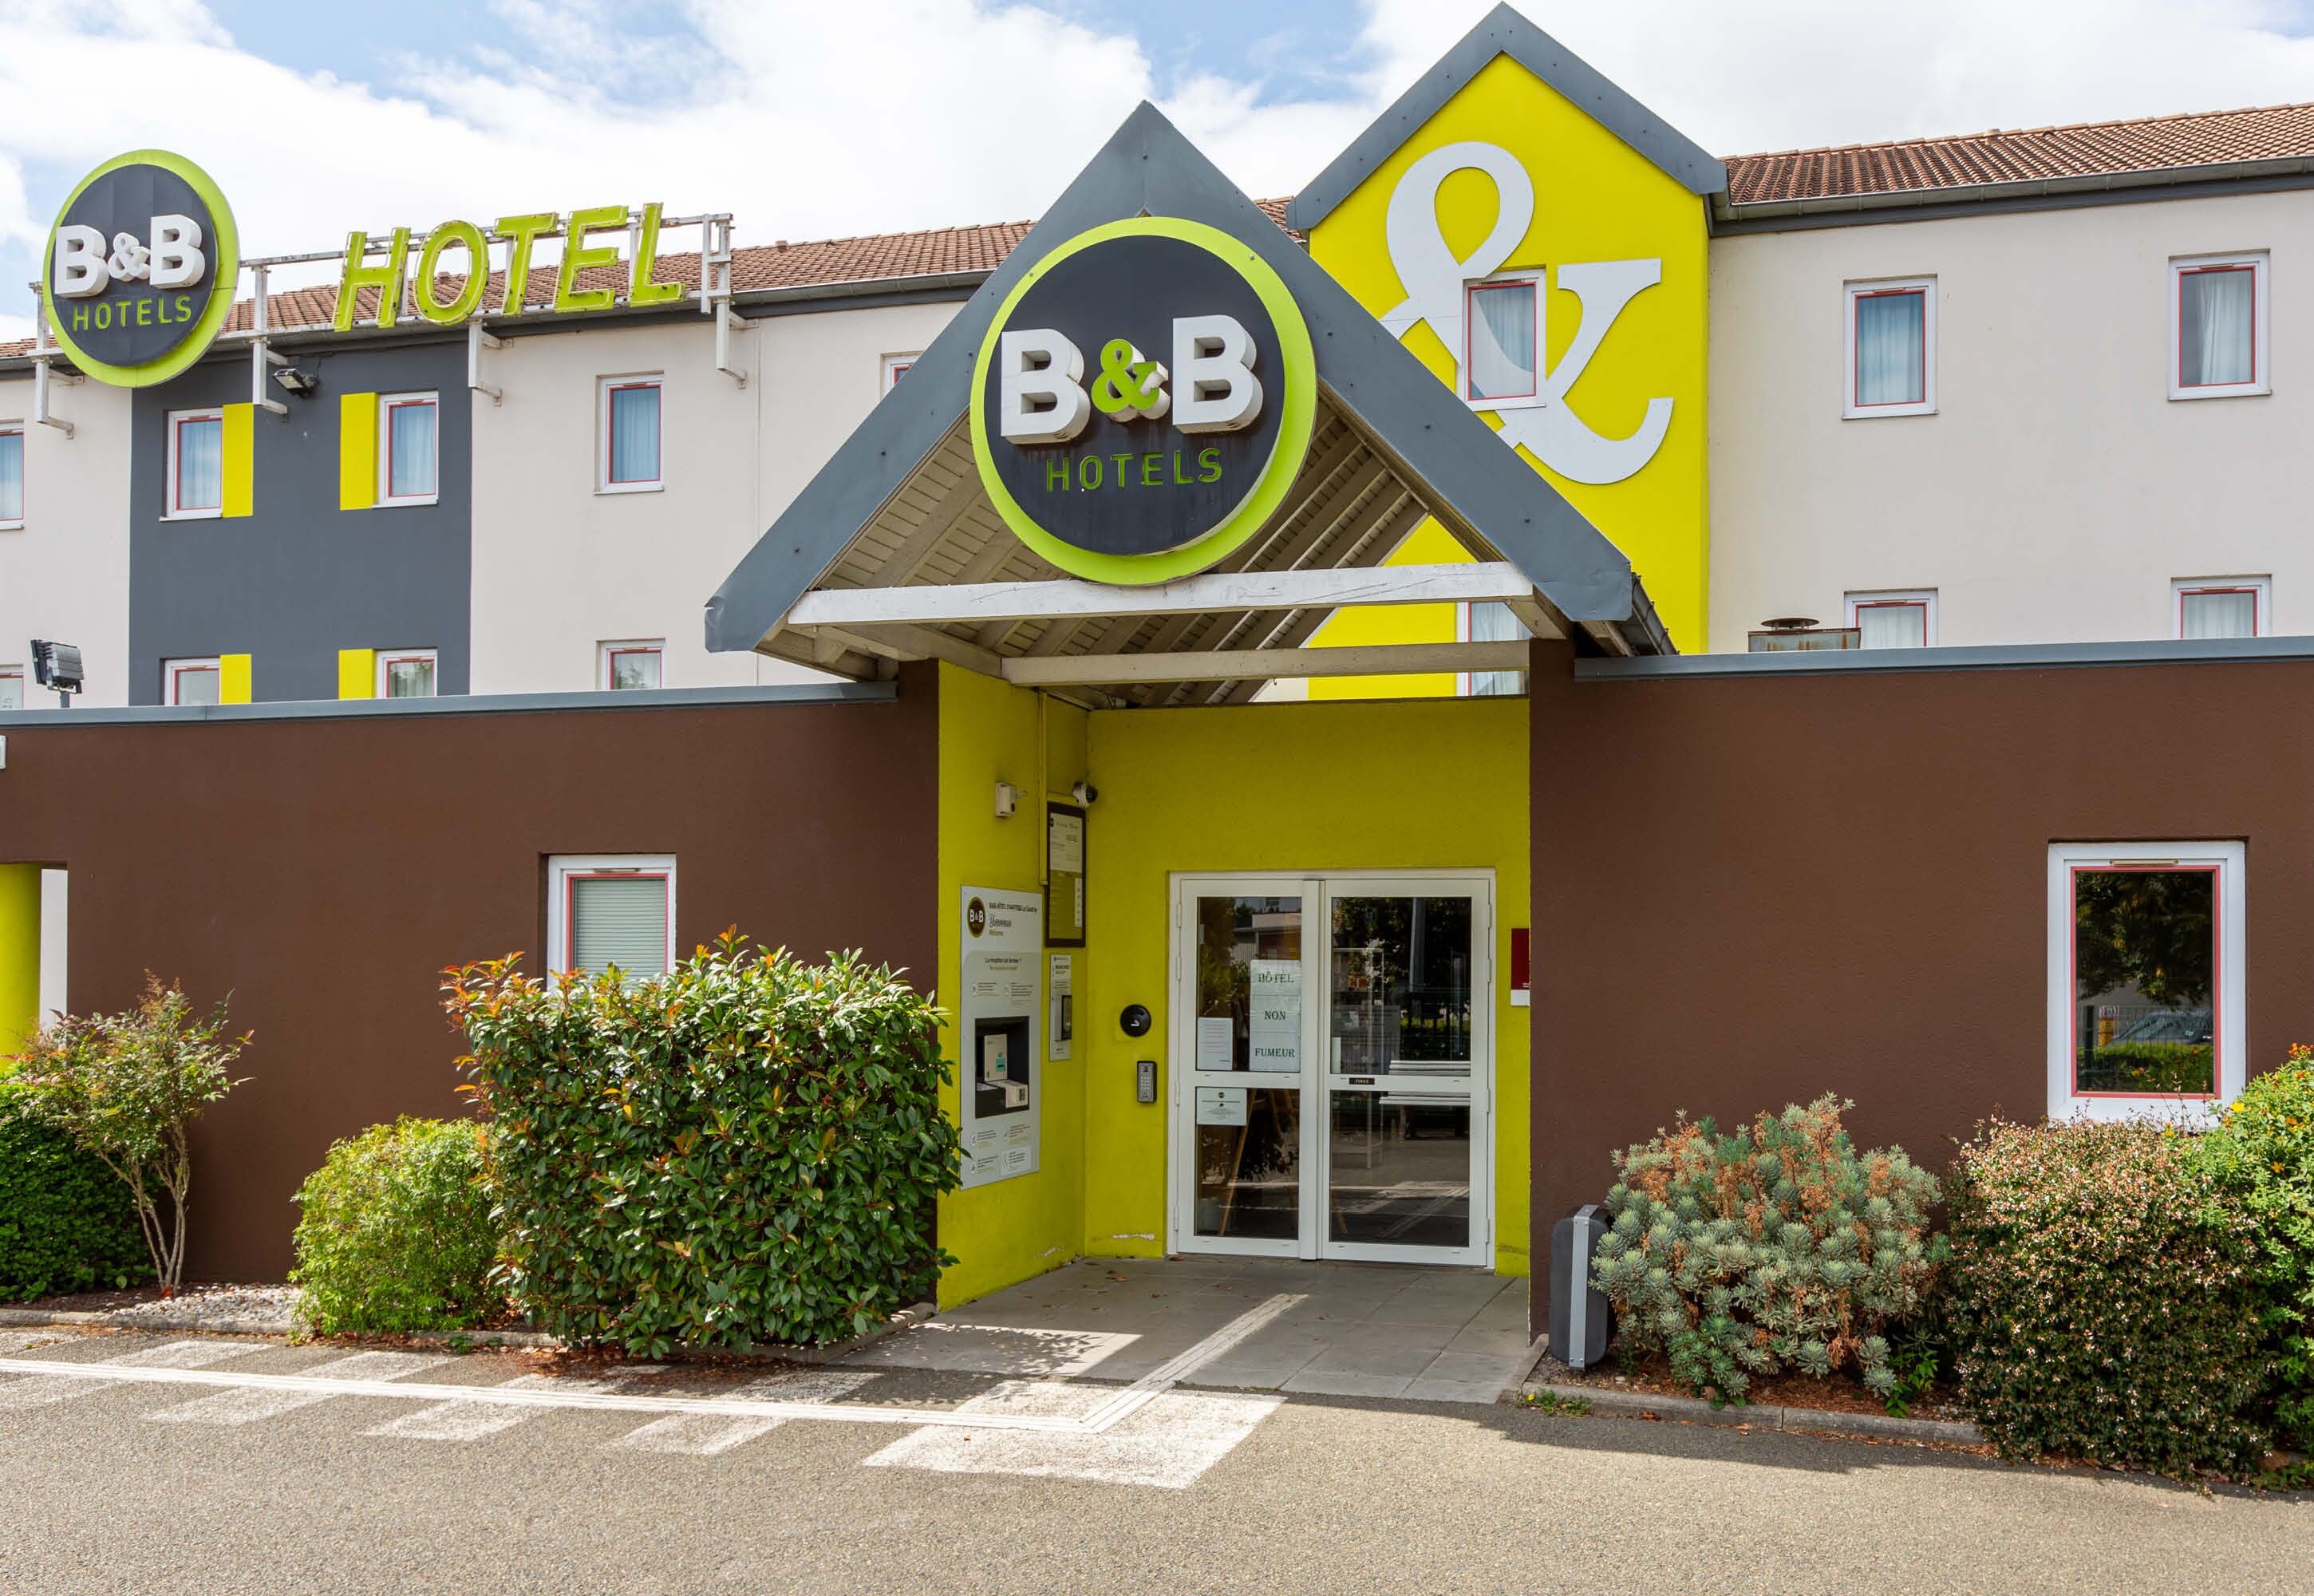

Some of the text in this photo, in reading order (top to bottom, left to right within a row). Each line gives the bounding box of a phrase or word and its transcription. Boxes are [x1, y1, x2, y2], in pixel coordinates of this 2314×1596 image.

[54, 214, 205, 298] B&B
[334, 202, 686, 332] HOTEL
[73, 295, 192, 331] HOTELS
[1001, 314, 1263, 444] B&B
[1046, 448, 1223, 492] HOTELS
[969, 909, 984, 923] B&B
[1264, 1010, 1286, 1021] NON
[1254, 1048, 1295, 1057] FUMEUR
